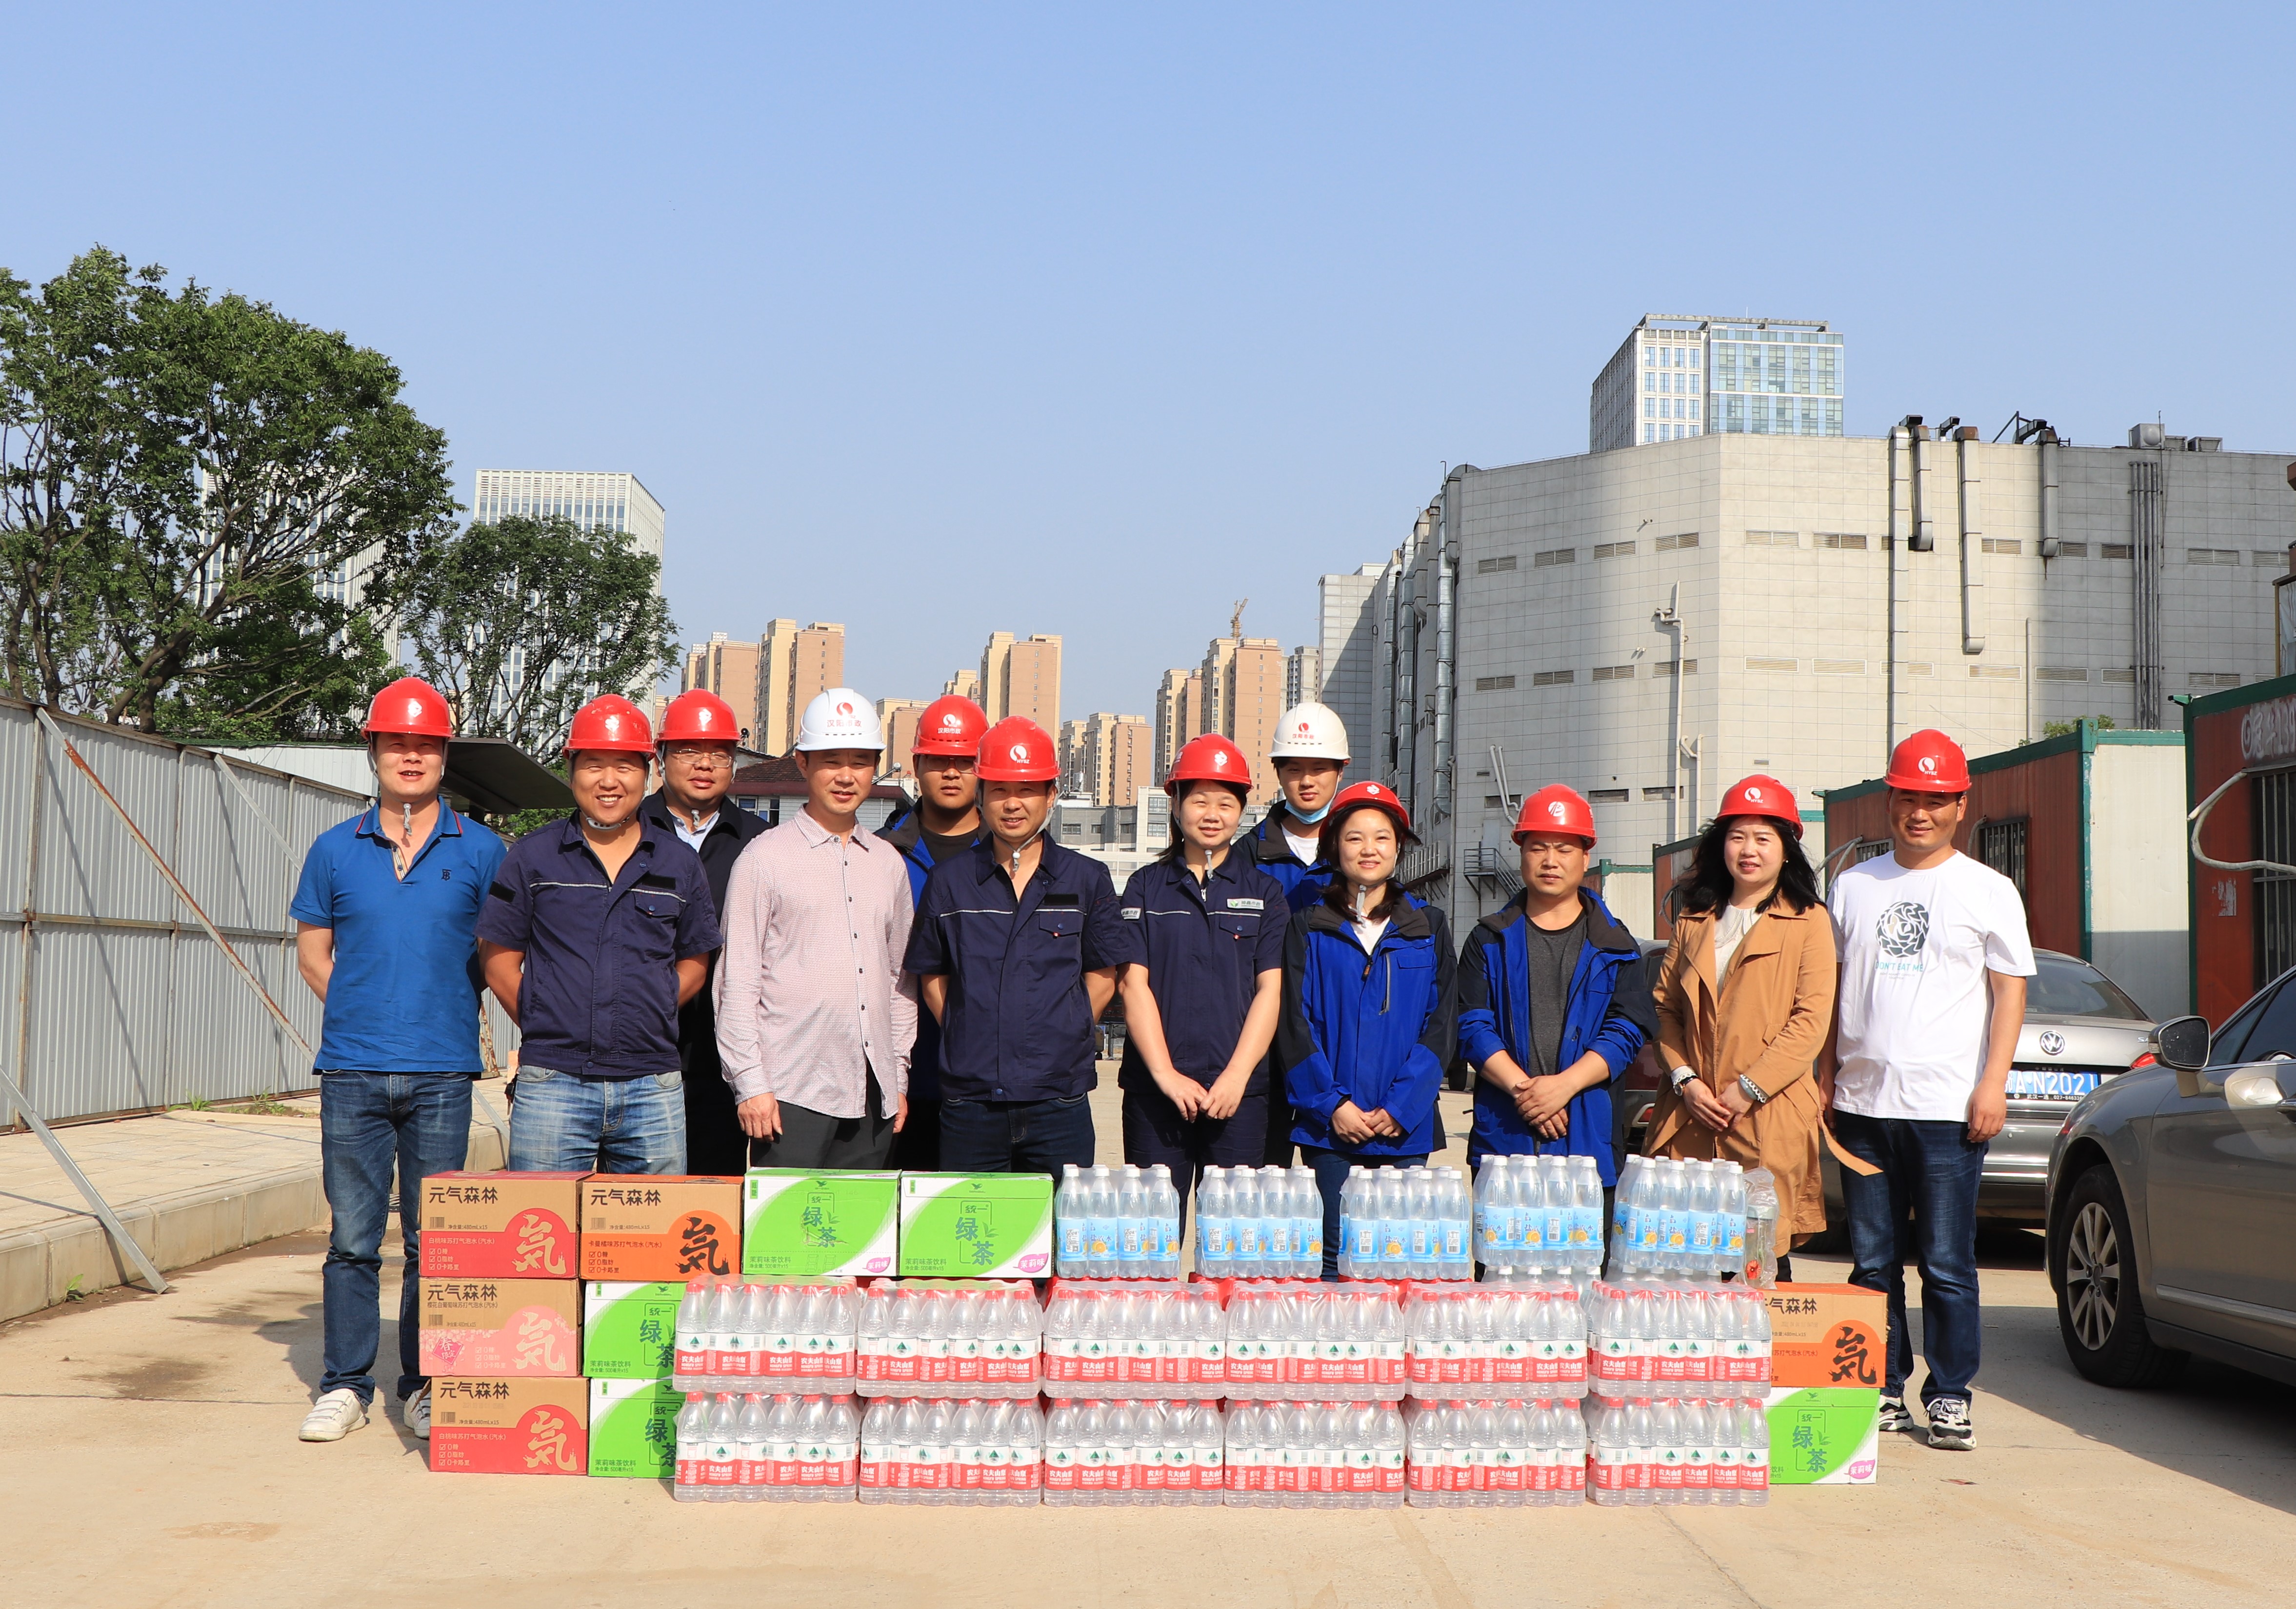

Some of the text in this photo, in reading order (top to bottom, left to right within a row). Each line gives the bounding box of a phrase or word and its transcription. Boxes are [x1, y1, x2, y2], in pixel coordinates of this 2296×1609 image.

[1876, 961, 1896, 970] DON'T
[429, 1187, 498, 1204] 元气森林
[591, 1189, 661, 1206] 元气森林
[803, 1206, 836, 1247] 绿茶
[956, 1217, 994, 1266] 绿茶
[427, 1284, 498, 1301] 元气森林
[440, 1382, 509, 1399] 元气森林
[1793, 1426, 1827, 1472] 绿茶
